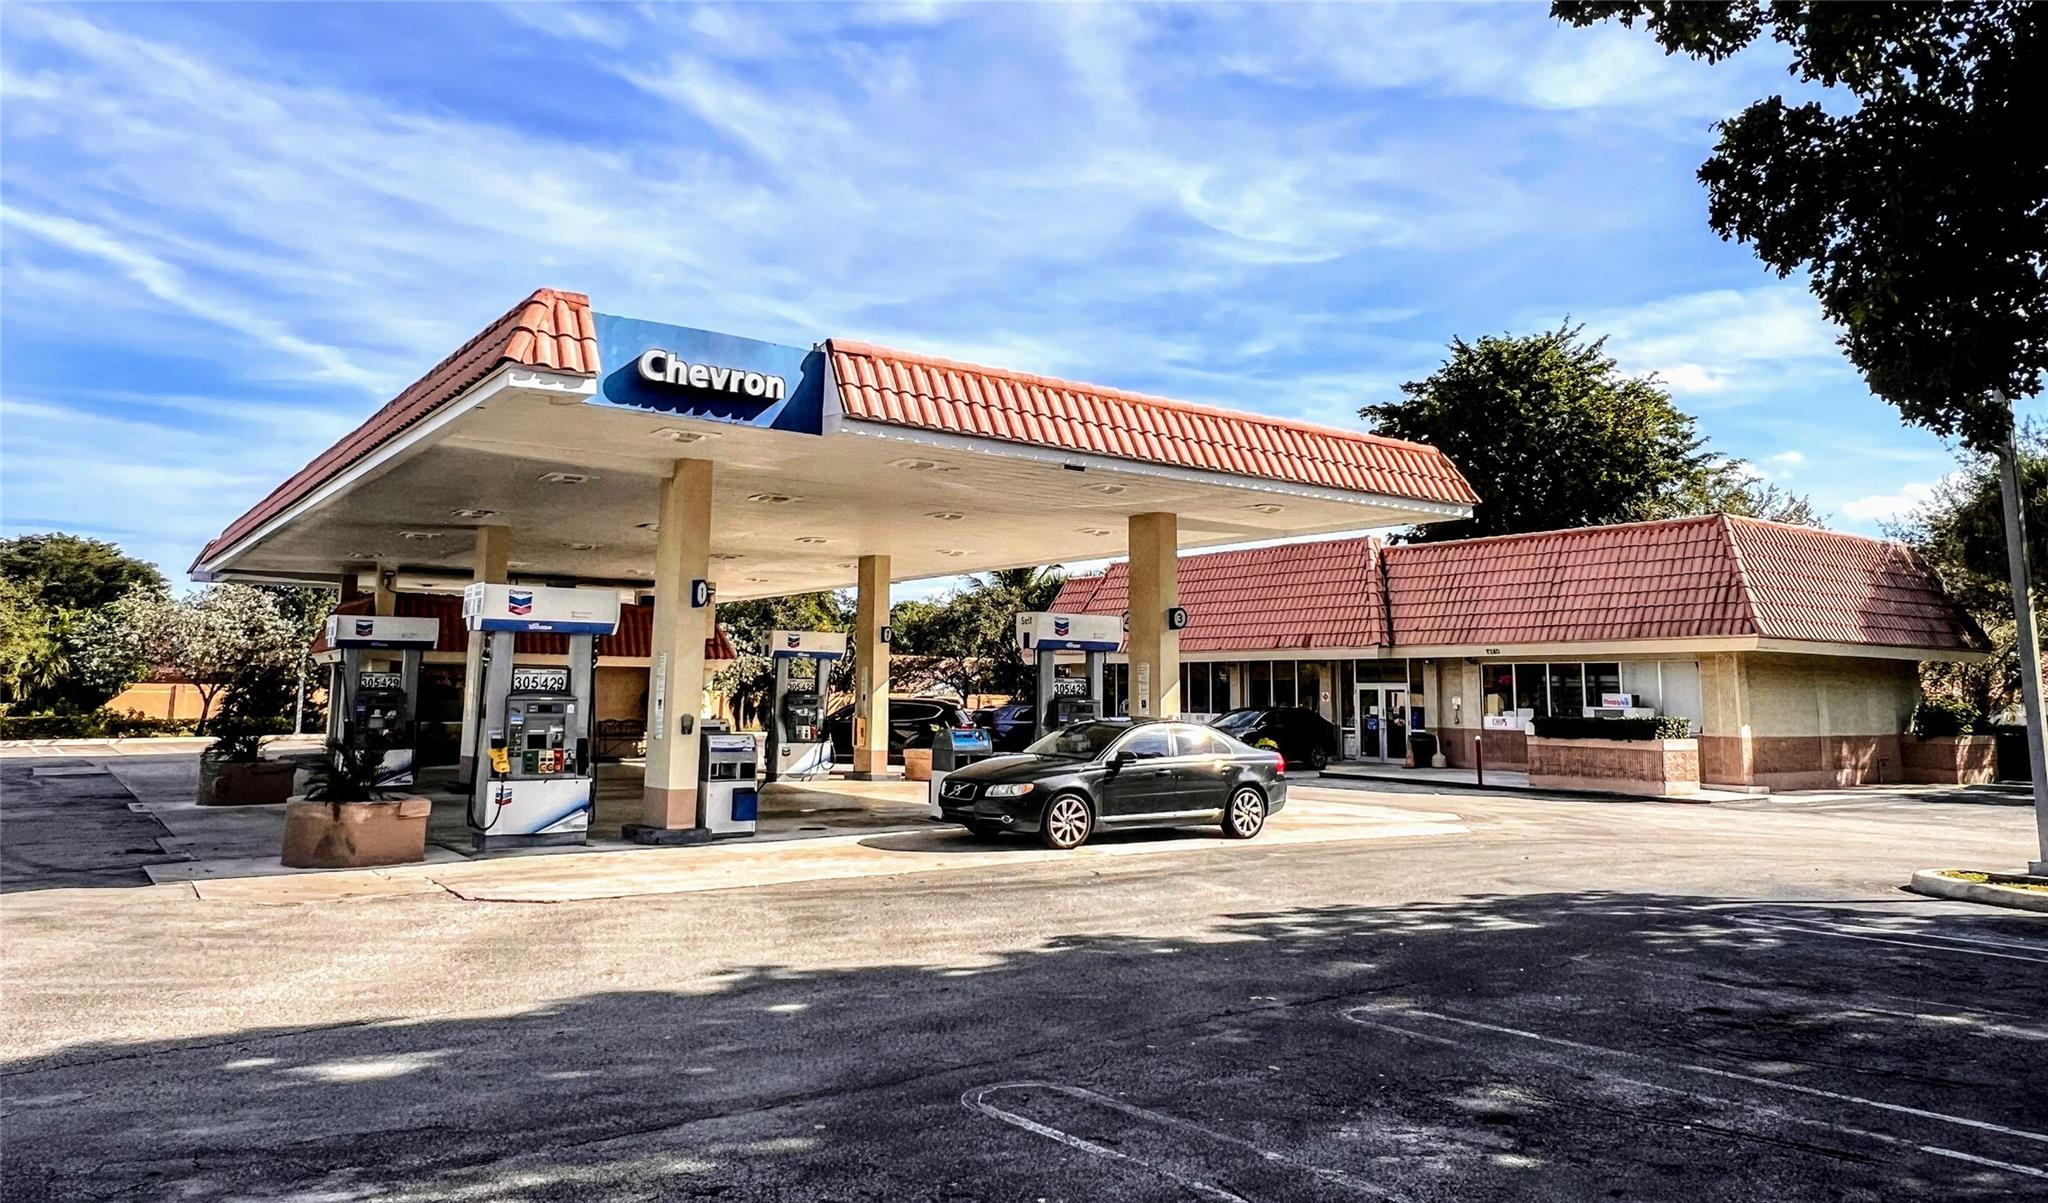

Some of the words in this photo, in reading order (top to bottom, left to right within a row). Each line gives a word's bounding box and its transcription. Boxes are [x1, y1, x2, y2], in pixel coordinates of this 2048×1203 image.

[638, 348, 785, 400] Chevron
[361, 678, 380, 688] 305
[514, 676, 539, 689] 305
[540, 676, 564, 690] 429
[1054, 683, 1069, 695] 305
[1069, 684, 1087, 695] 429
